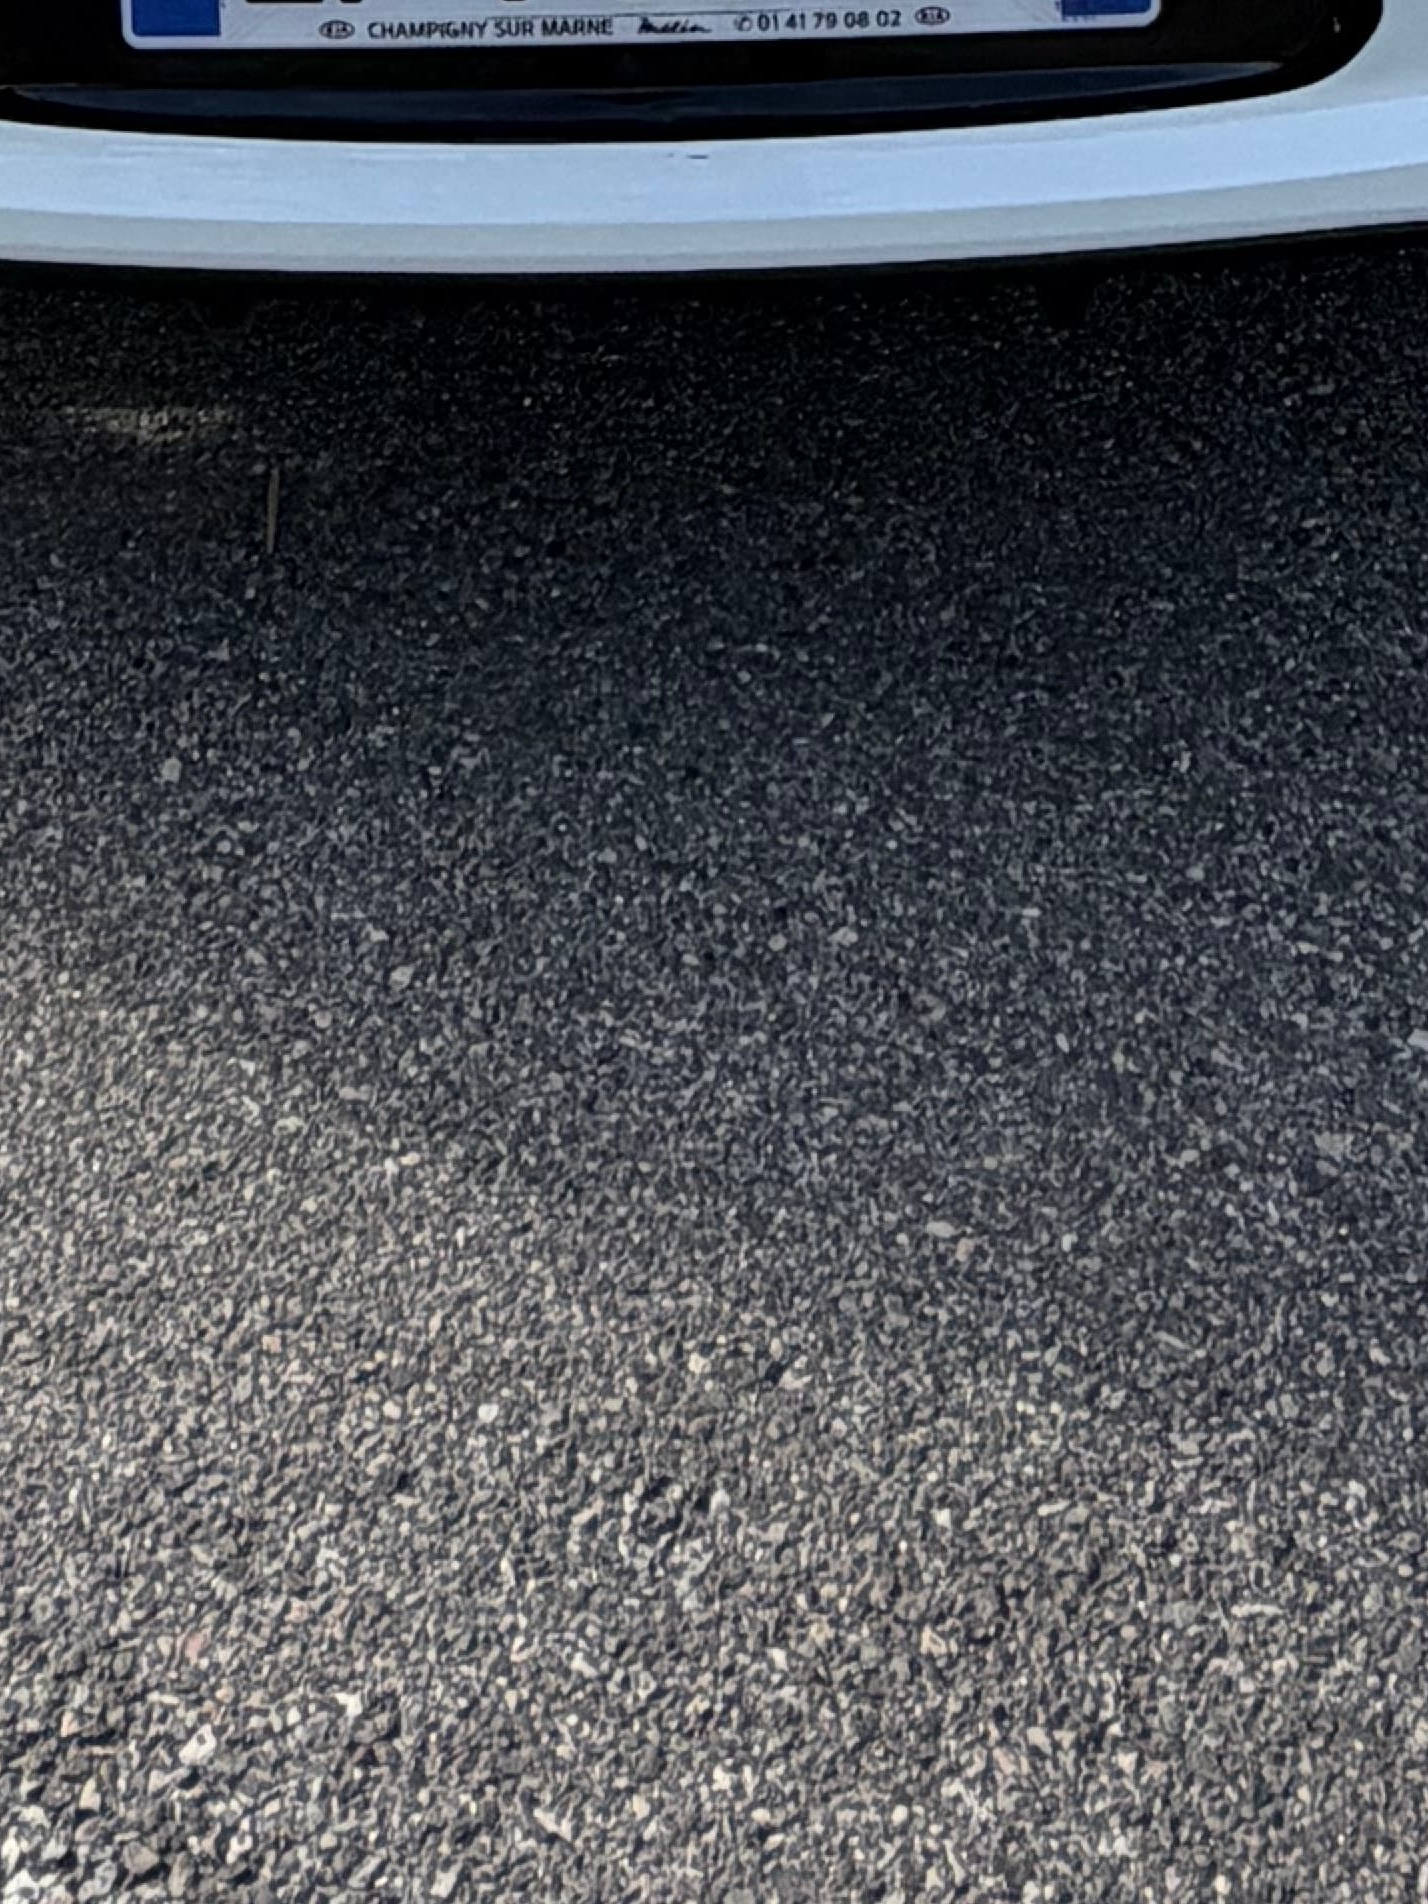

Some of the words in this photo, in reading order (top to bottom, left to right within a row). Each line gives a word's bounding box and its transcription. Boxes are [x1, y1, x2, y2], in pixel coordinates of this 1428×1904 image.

[367, 19, 488, 40] CHAMPIGNY
[493, 17, 535, 38] SUR
[540, 15, 613, 37] MARNE
[756, 12, 780, 32] 01
[785, 11, 806, 31] 41
[813, 11, 838, 30] 79
[843, 10, 870, 29] 08
[875, 9, 902, 28] 02
